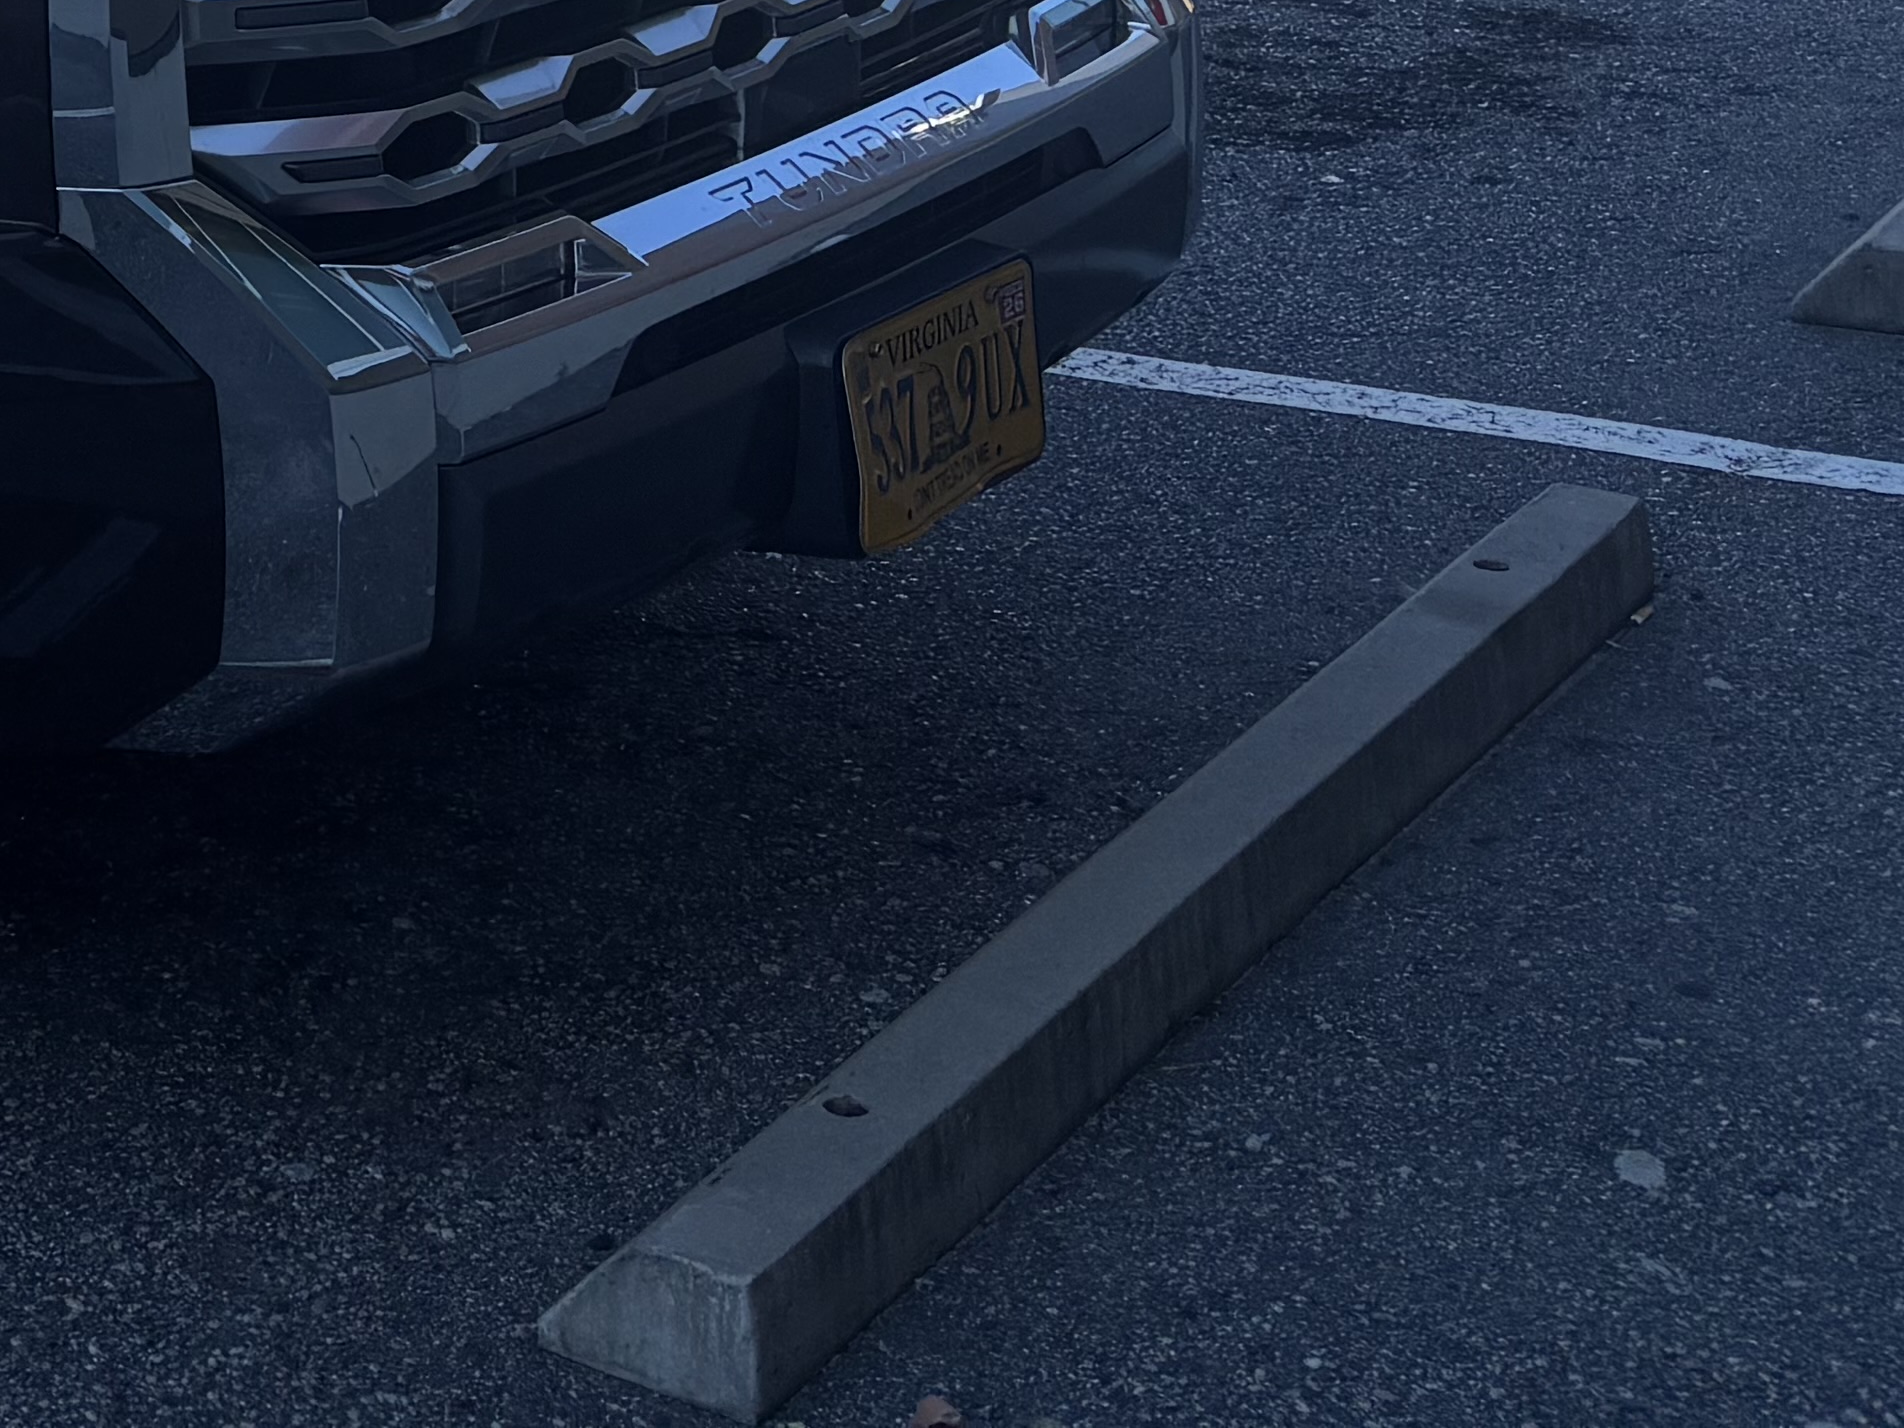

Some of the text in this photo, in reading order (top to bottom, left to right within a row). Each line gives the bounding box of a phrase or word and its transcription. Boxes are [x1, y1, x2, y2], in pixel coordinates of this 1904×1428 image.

[708, 90, 985, 228] TUNDRA
[886, 299, 979, 368] VIRGINIA
[1003, 293, 1025, 320] 26
